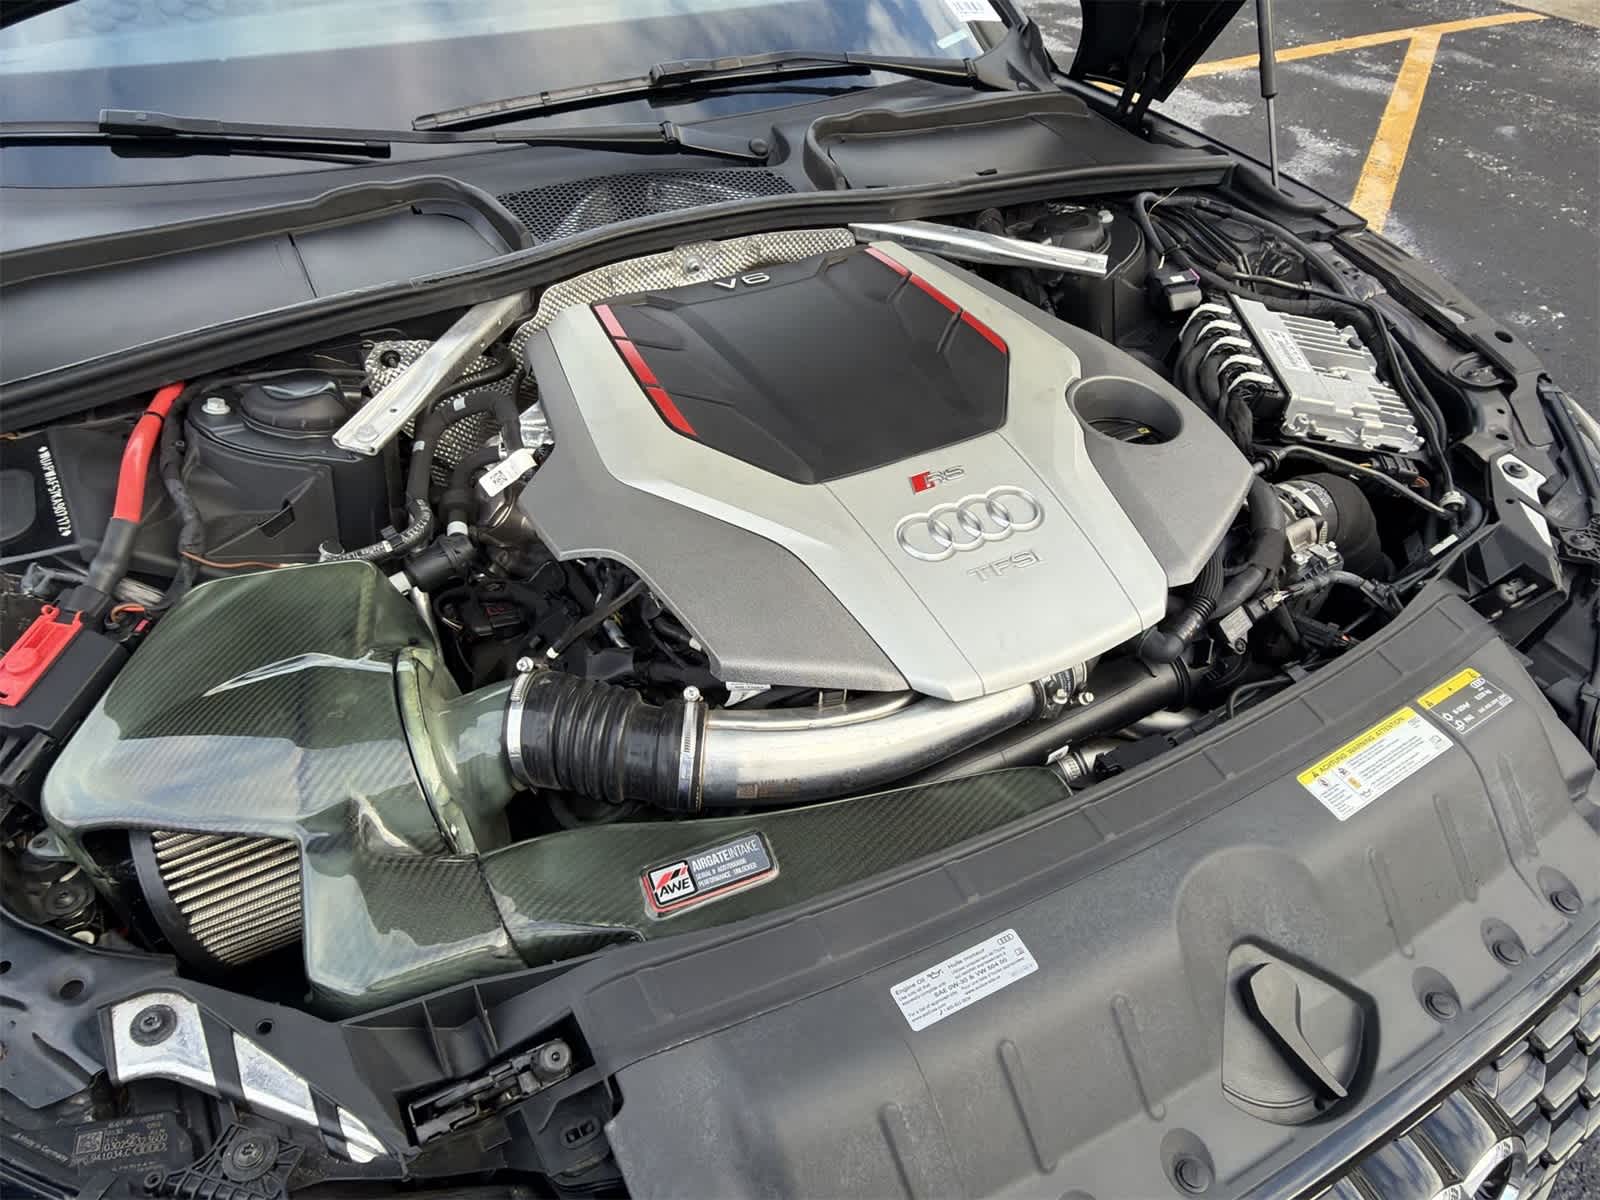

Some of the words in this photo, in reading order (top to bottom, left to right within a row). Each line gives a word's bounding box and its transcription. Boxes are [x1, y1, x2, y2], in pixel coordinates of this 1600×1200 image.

[714, 272, 770, 289] V6
[911, 464, 965, 494] RS
[966, 549, 1042, 582] TFSI
[1348, 735, 1376, 755] WARNING
[1375, 717, 1405, 737] ATTENTION
[659, 877, 691, 898] AWE
[895, 983, 916, 996] Engine
